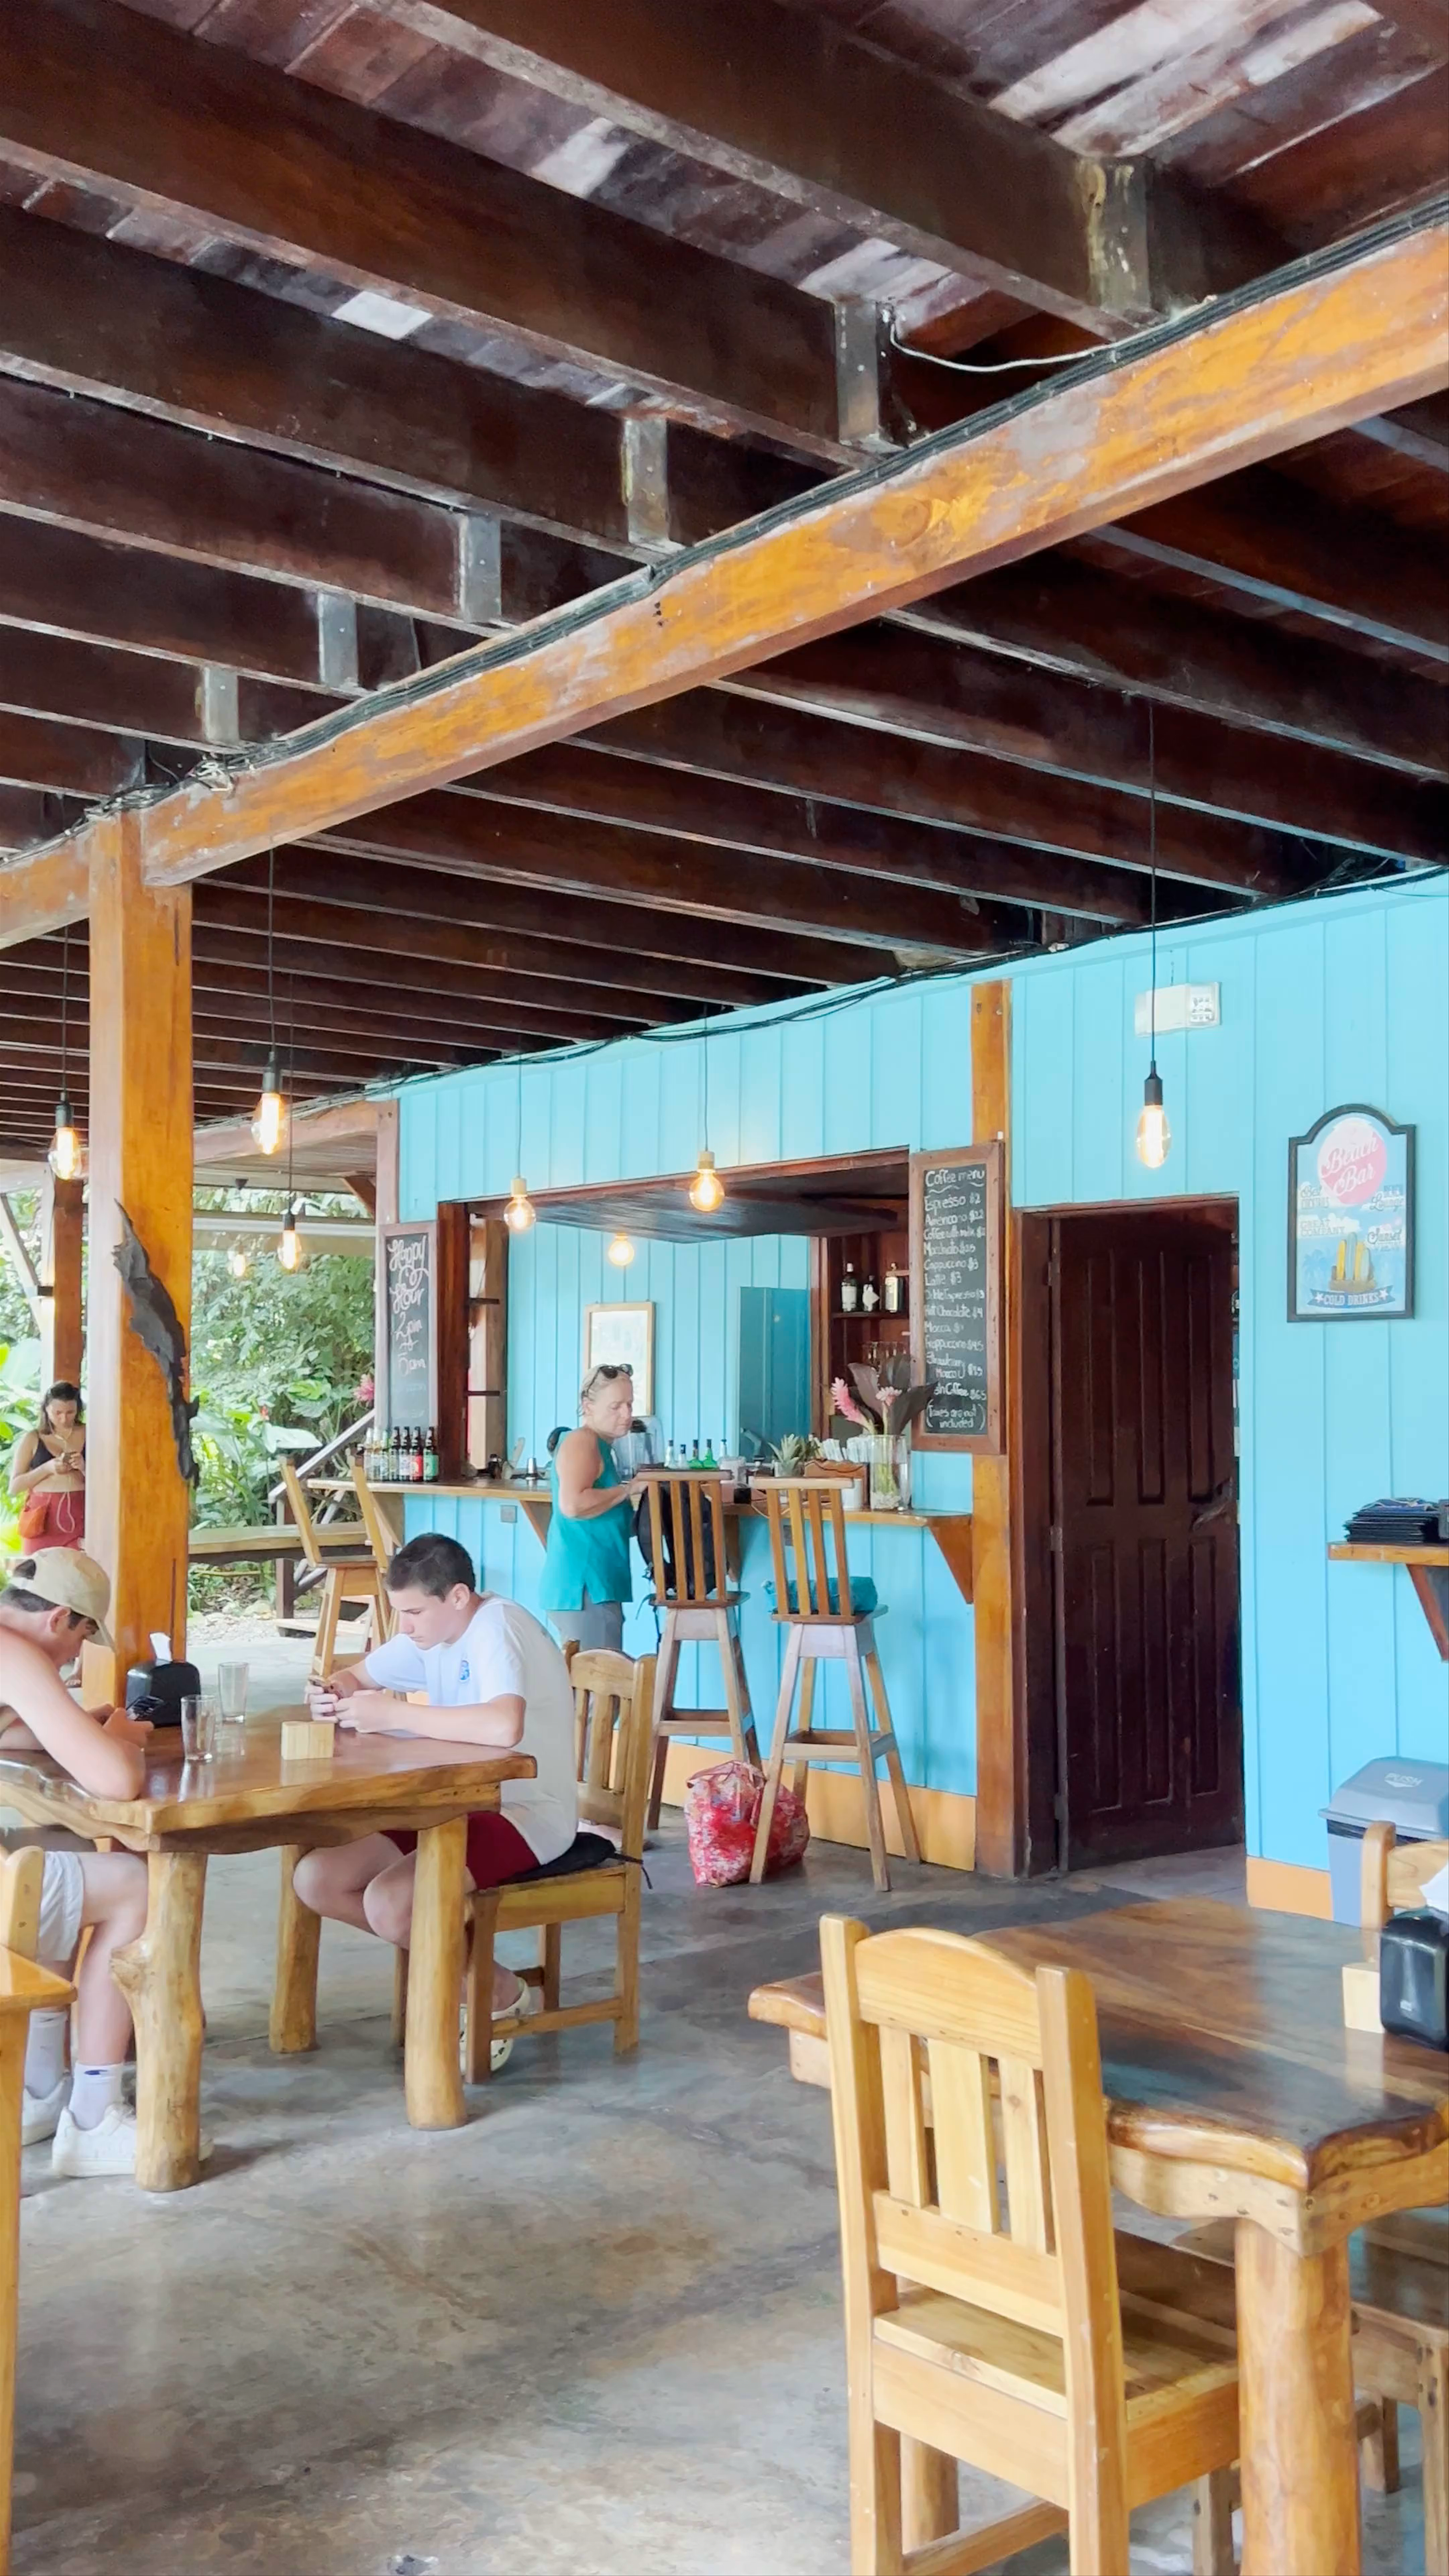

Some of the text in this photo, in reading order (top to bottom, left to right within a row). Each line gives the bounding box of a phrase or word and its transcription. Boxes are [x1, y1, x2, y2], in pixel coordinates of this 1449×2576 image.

[1321, 1137, 1378, 1178] Beach
[925, 1169, 956, 1187] Coffee
[1333, 1163, 1376, 1196] Bar
[924, 1194, 966, 1215] Espresso
[387, 1235, 429, 1284] Happy
[389, 1283, 425, 1314] Hour
[1323, 1291, 1379, 1306] COLD DRINKS
[1385, 1772, 1424, 1786] PUSH
